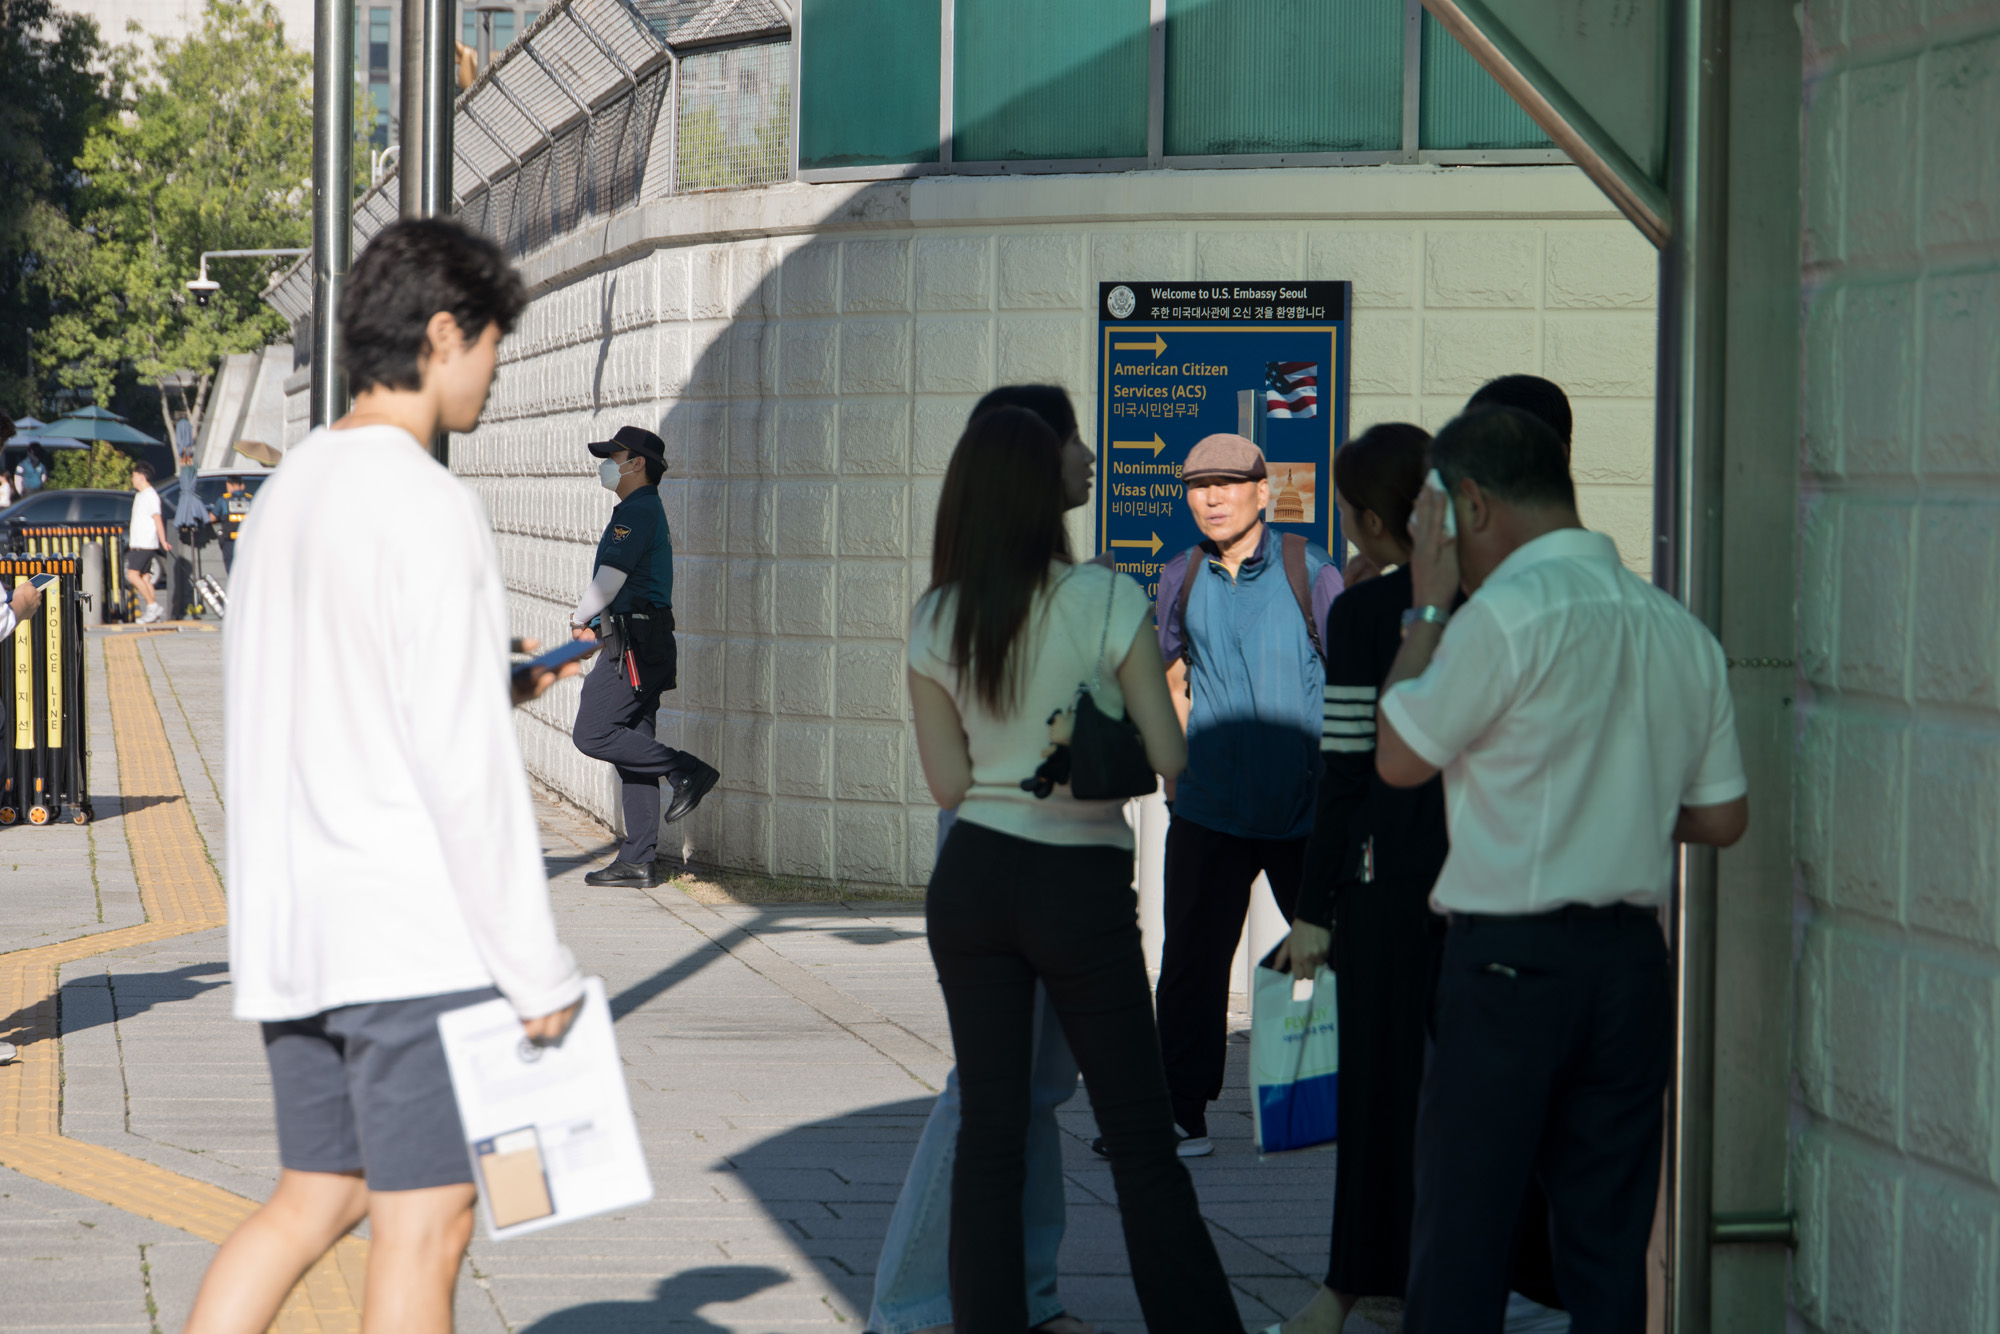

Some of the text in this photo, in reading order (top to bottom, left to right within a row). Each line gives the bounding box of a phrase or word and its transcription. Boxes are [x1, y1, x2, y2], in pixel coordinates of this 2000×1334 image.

[1151, 287, 1308, 301] Welcome to U.S. Embassy Seoul
[1151, 306, 1326, 319] 주한 미국대사관에 오신 것을 환영합니다
[1113, 362, 1228, 376] American Citizen
[1113, 384, 1207, 401] Services (ACS)
[1113, 402, 1200, 418] 미국시민업무과
[1113, 461, 1183, 478] Nonimmig
[1112, 483, 1183, 500] Visas (NIV)
[1112, 501, 1173, 517] 비이민비자
[1114, 560, 1166, 577] mmigra
[1147, 583, 1160, 598] (I
[49, 606, 58, 730] POLICE LINE
[17, 635, 29, 731] 서유지선
